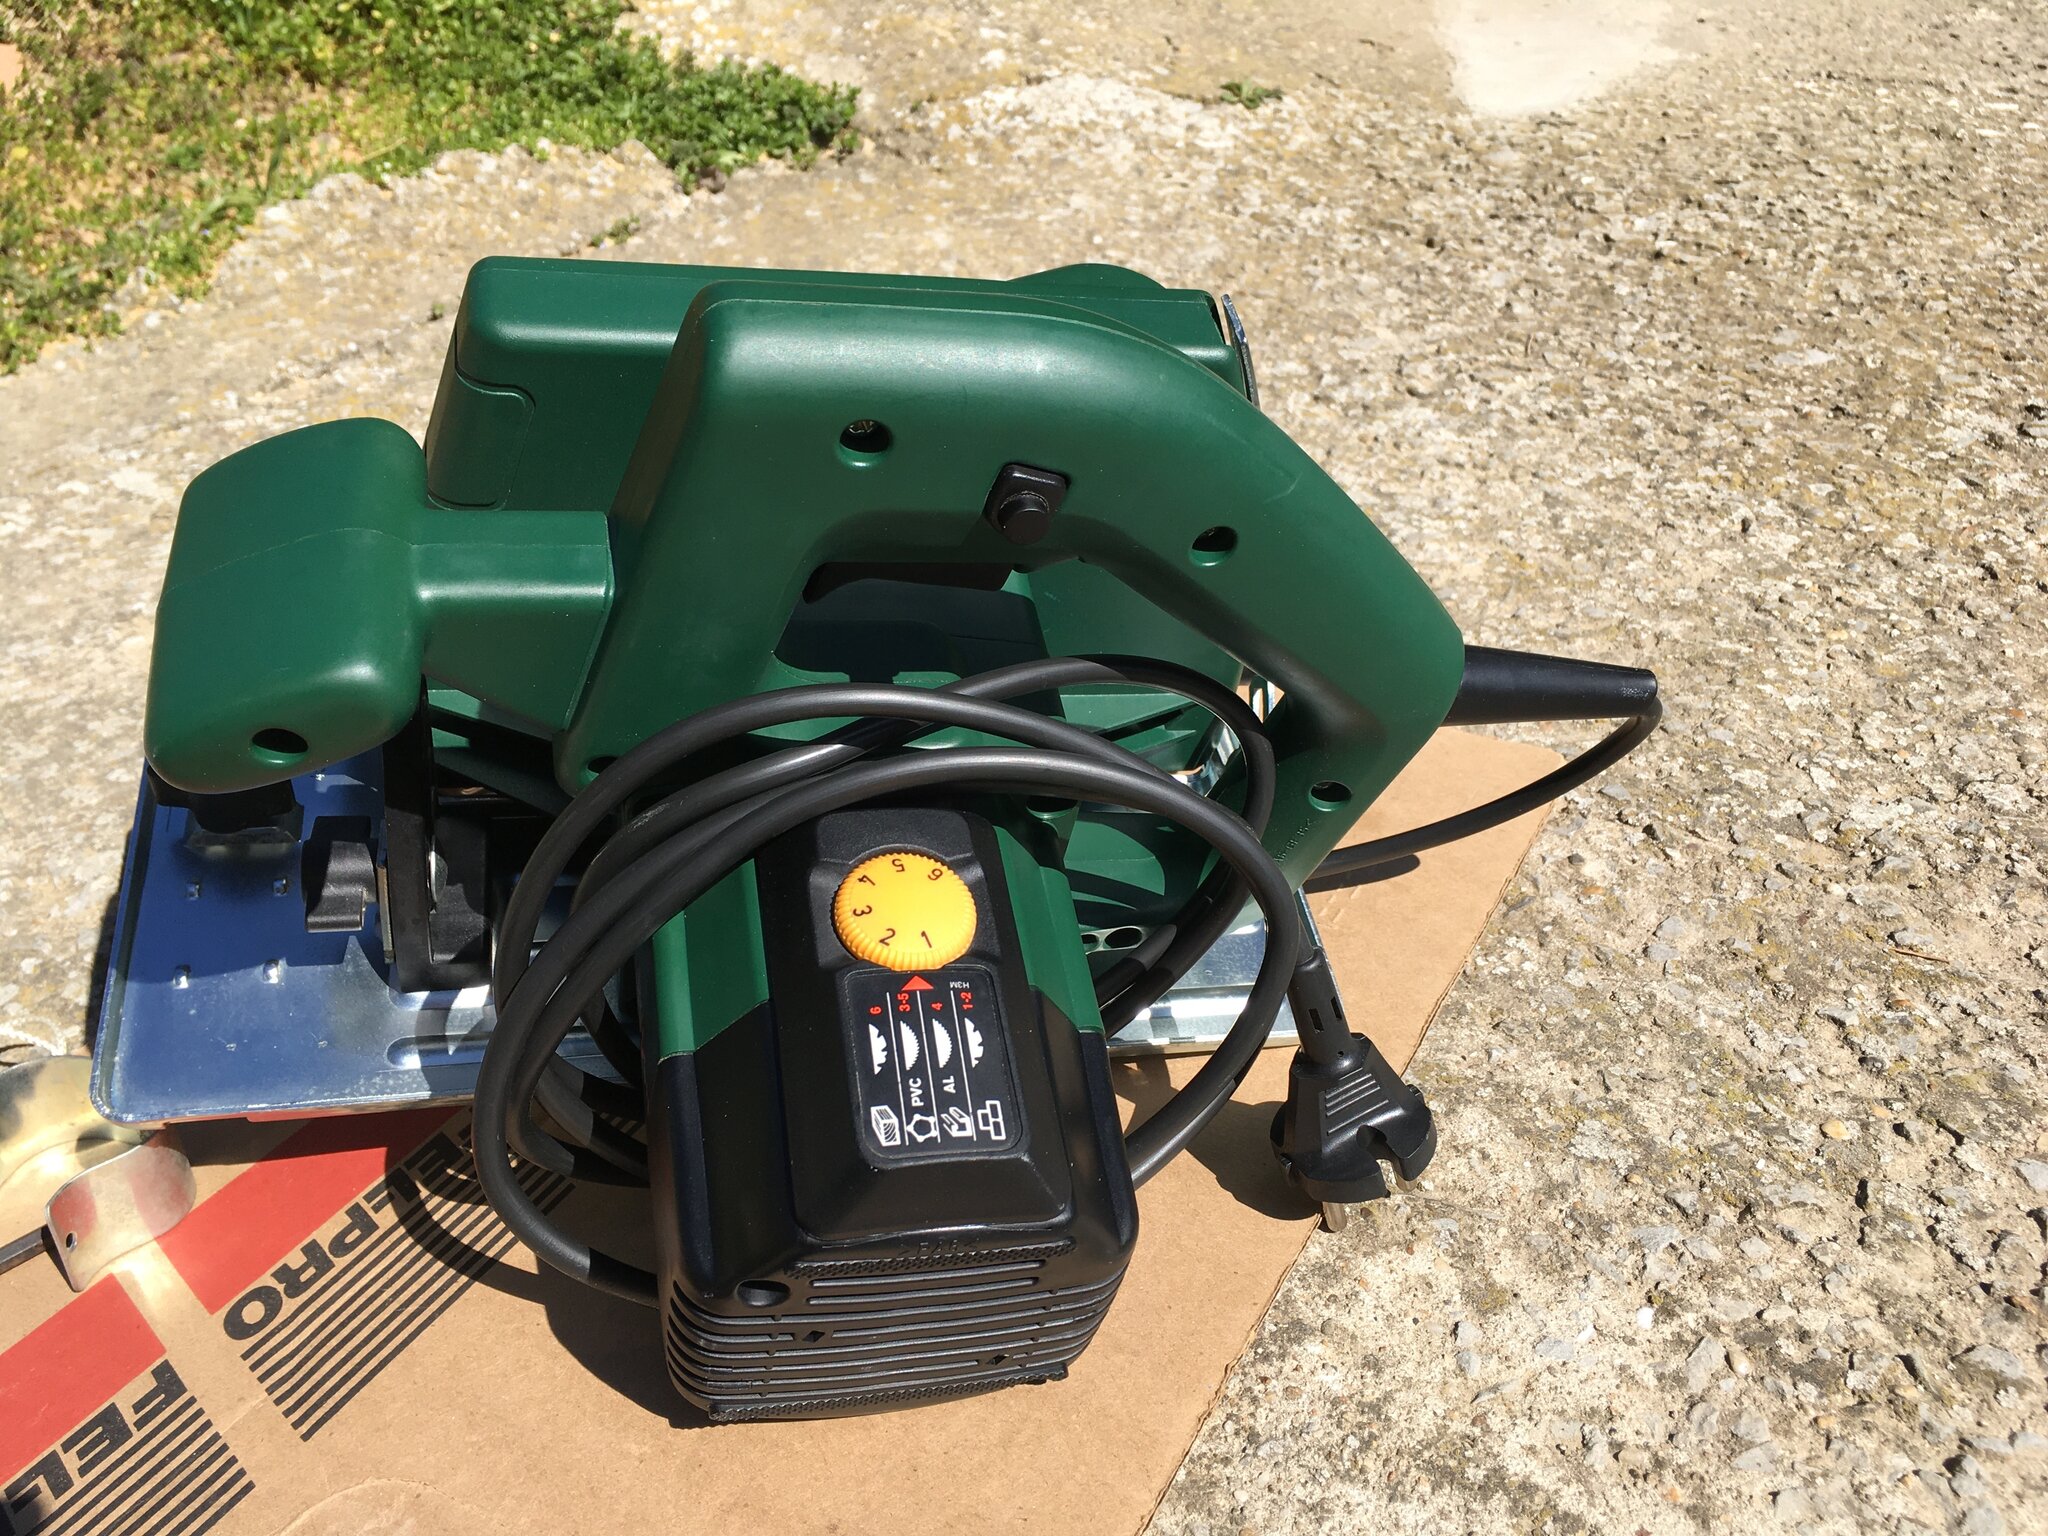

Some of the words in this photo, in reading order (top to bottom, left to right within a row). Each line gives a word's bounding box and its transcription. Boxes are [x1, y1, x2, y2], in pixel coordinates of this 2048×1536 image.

[892, 858, 905, 872] 5
[857, 874, 875, 886] 4
[928, 868, 943, 881] 6
[853, 905, 872, 916] 3
[879, 928, 896, 946] 2
[921, 930, 932, 948] 1
[898, 993, 910, 1012] 3-5
[932, 1002, 942, 1011] 4
[961, 992, 973, 1010] 1-2
[870, 1006, 881, 1015] 6
[909, 1077, 924, 1107] PVC
[942, 1075, 956, 1093] AL
